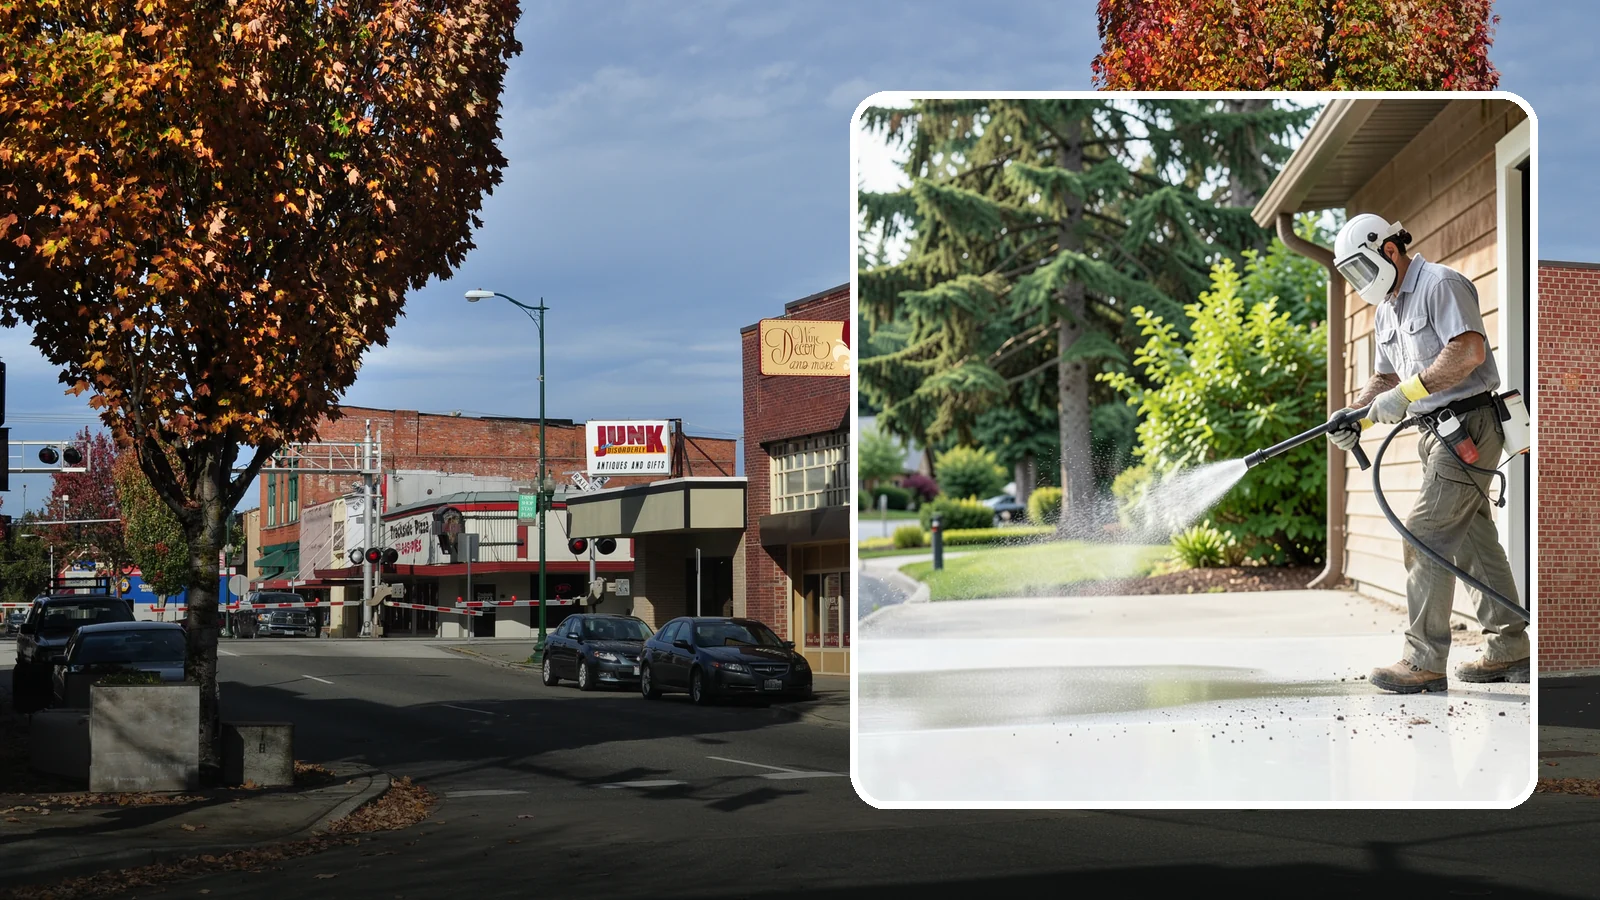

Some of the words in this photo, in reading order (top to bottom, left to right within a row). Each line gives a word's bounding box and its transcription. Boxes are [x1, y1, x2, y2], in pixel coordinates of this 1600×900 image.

[596, 425, 665, 457] JUNK
[607, 446, 646, 454] DISORDERLY
[597, 461, 628, 470] ANTIQUES
[631, 461, 644, 470] AND
[647, 460, 665, 469] GIFTS
[390, 521, 412, 539] Trackside
[414, 519, 429, 534] Pizza
